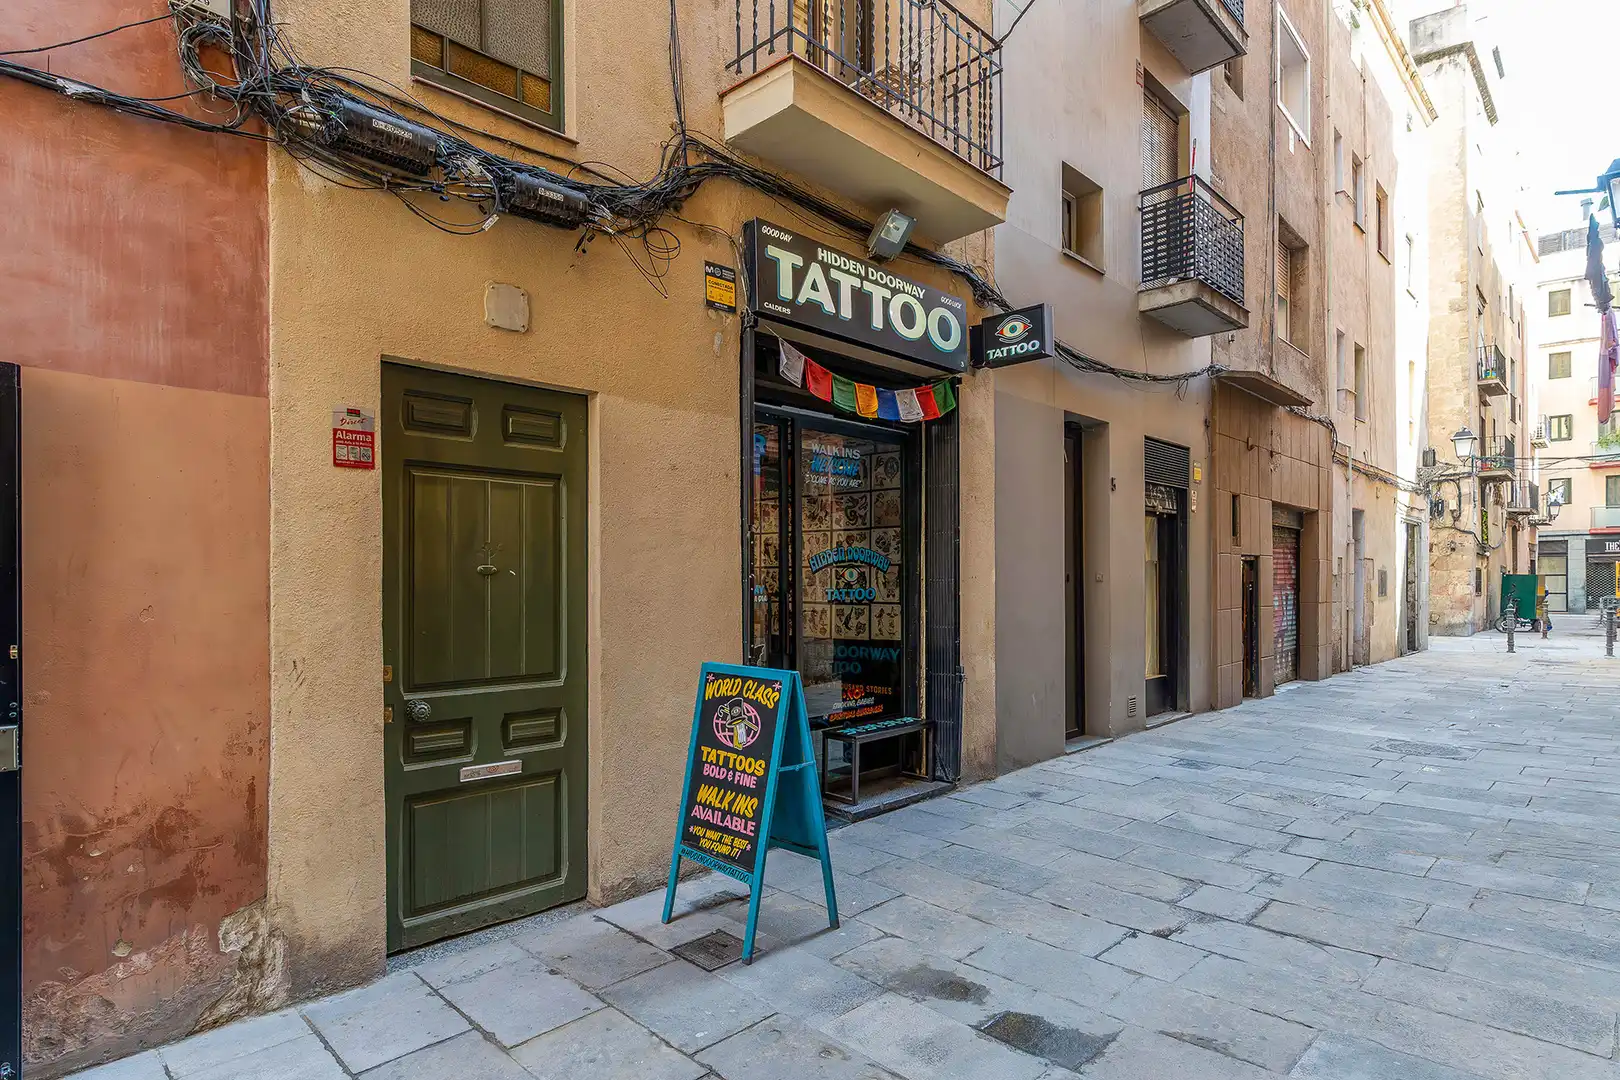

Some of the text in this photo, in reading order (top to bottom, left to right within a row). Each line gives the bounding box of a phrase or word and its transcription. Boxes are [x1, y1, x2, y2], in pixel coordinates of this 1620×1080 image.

[761, 225, 793, 243] GOOD DAY
[818, 247, 926, 299] HIDDEN DOORWAY
[763, 301, 791, 315] CALDERS
[765, 244, 961, 353] TATTOO
[986, 340, 1041, 360] TATTOO
[336, 430, 372, 442] Alarma
[812, 443, 861, 460] WALK INS
[1111, 477, 1117, 492] 5
[809, 546, 891, 574] HIDDEN DOORWAY
[826, 587, 877, 602] TATTOO
[705, 678, 780, 709] WORLD CLASS
[701, 746, 766, 777] TATTOOS
[703, 763, 758, 789] BOLD & FINE
[696, 783, 759, 819] WALK INS
[690, 804, 756, 837] AVAILABLE
[693, 825, 749, 850] YOU WANT THE BEST
[698, 837, 711, 849] YOU
[710, 841, 731, 855] FOUND
